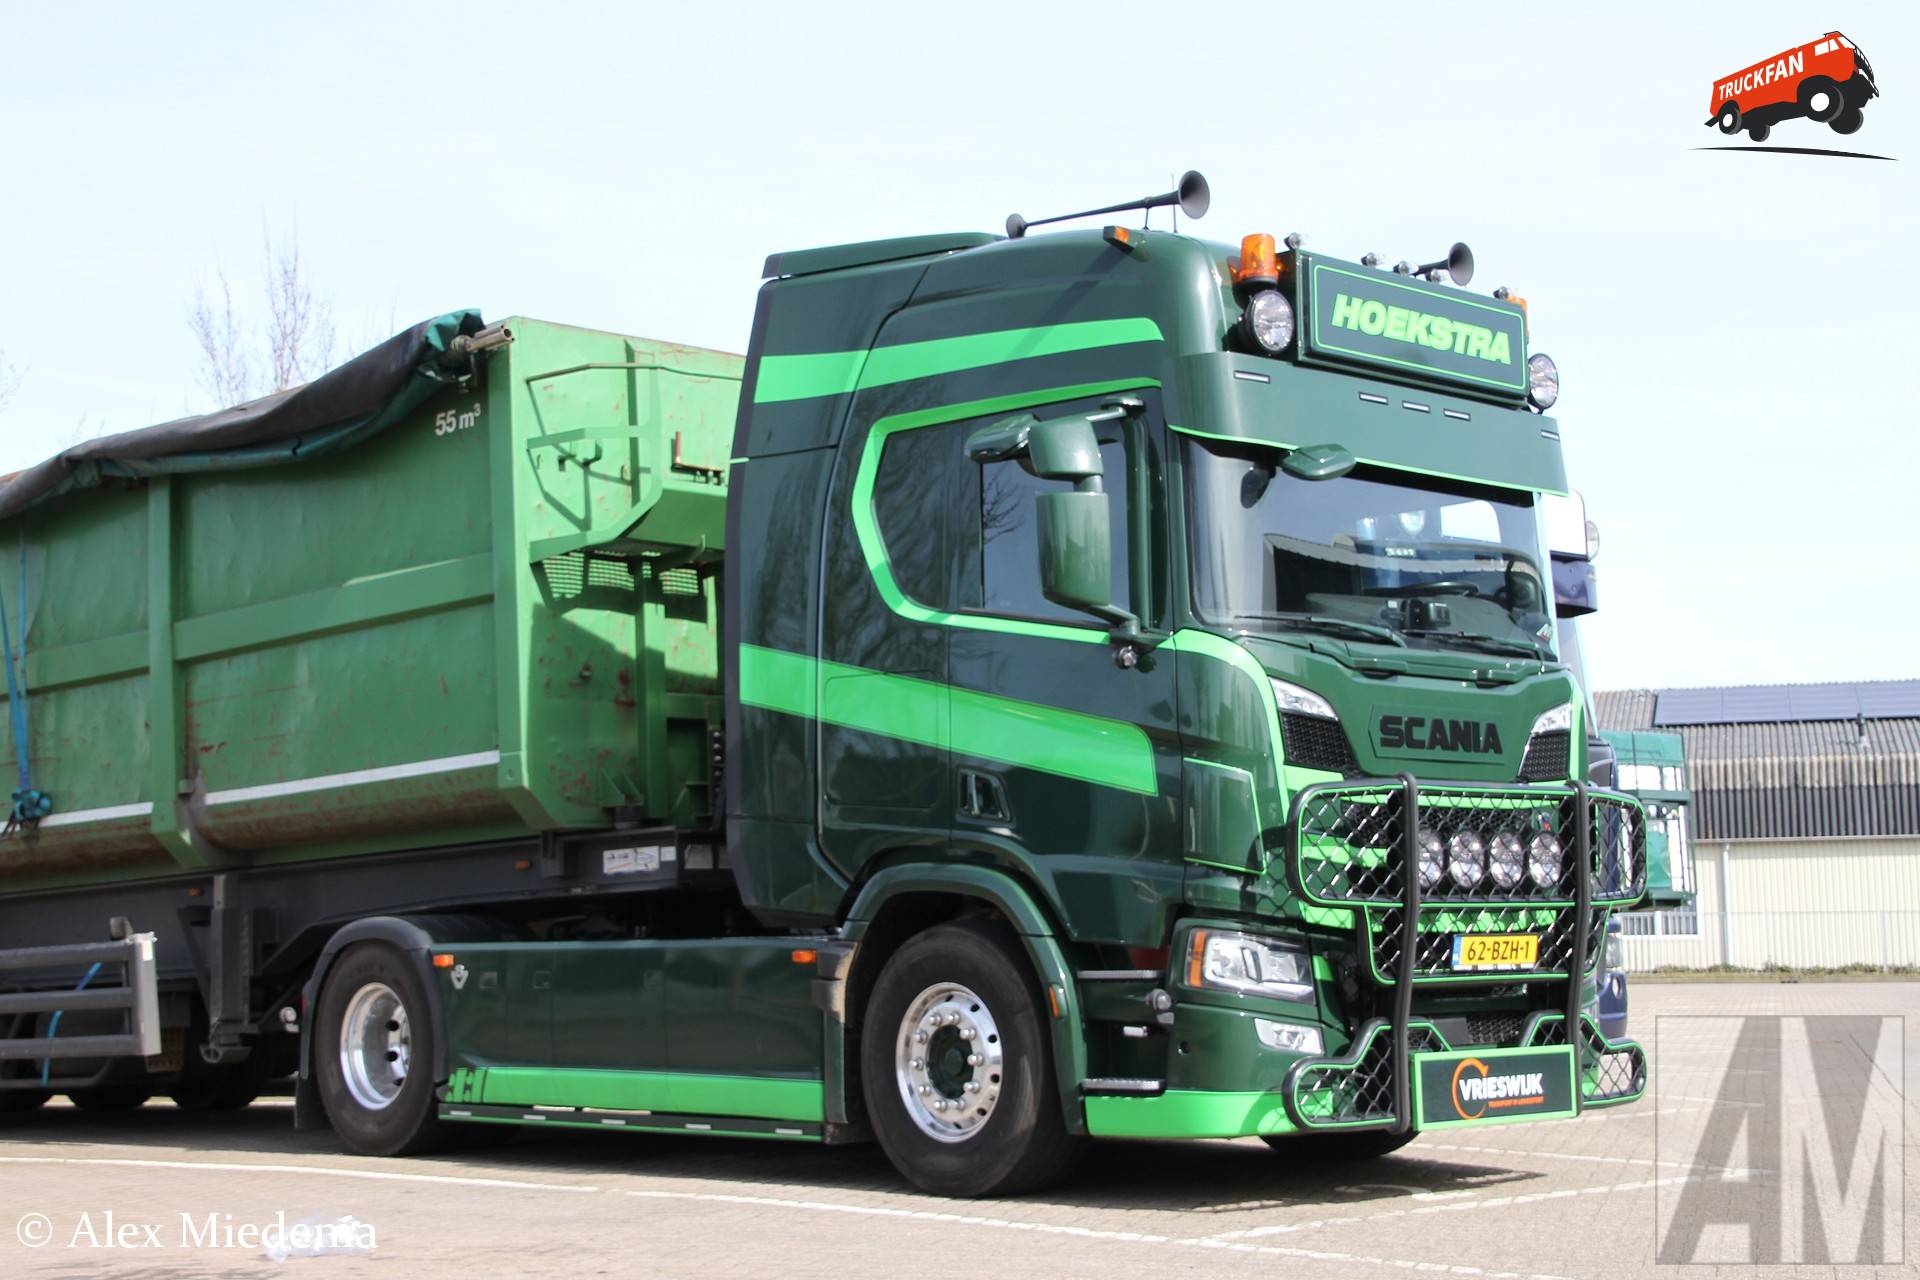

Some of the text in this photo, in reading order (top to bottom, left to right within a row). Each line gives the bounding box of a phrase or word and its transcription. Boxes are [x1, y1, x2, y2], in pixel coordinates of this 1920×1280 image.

[1331, 293, 1512, 365] HOEKSTRA
[434, 409, 457, 436] 55
[1379, 715, 1503, 754] SCANIA
[1467, 940, 1530, 961] 62-BZH-1
[1458, 1073, 1544, 1101] VRIESWIJK
